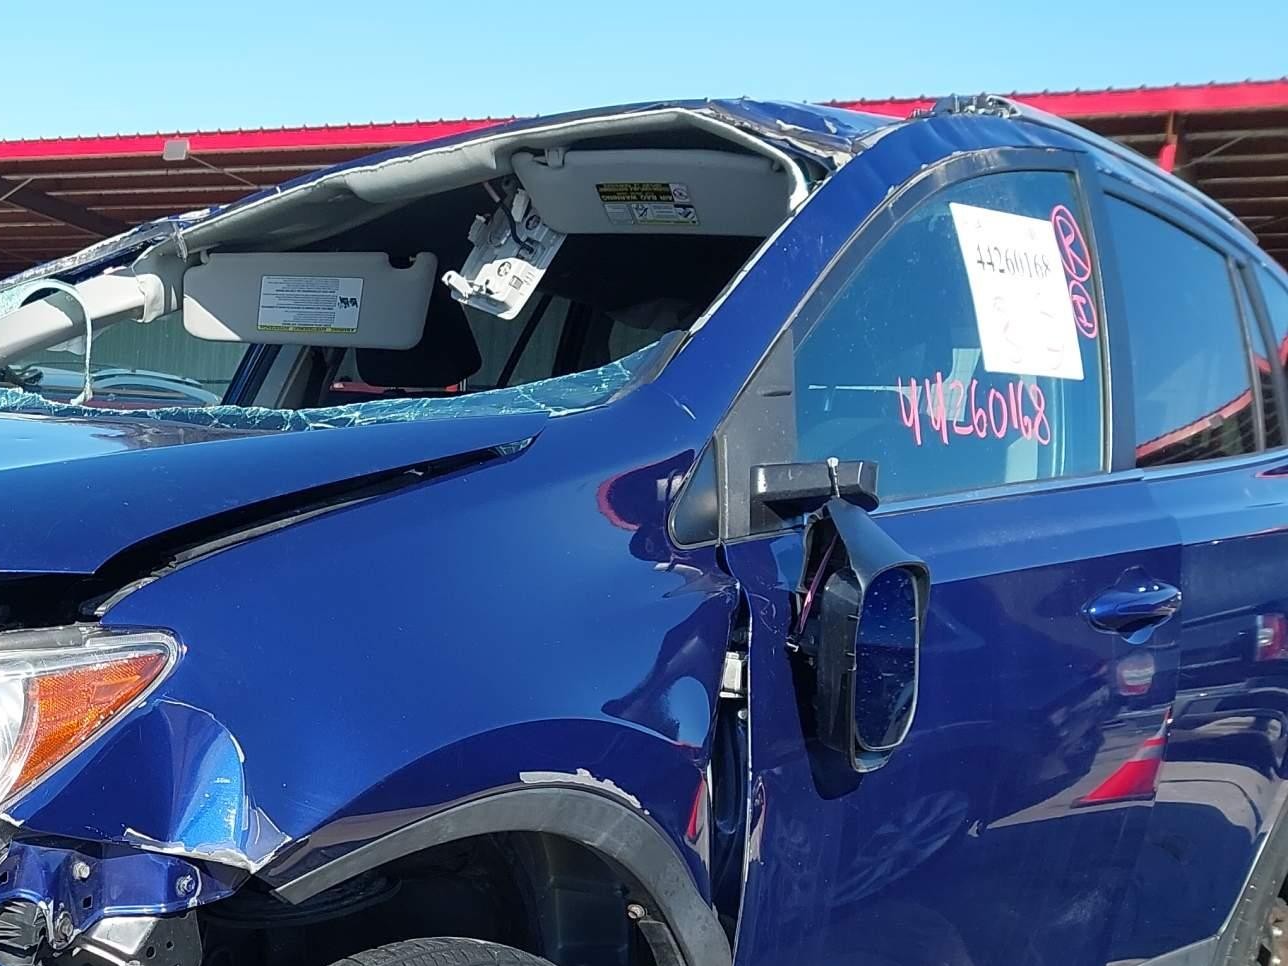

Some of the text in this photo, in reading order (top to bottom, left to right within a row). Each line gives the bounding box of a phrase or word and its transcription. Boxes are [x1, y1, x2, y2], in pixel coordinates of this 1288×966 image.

[976, 243, 1051, 279] 44260168
[1054, 212, 1090, 277] R
[897, 371, 1051, 446] 44260168
